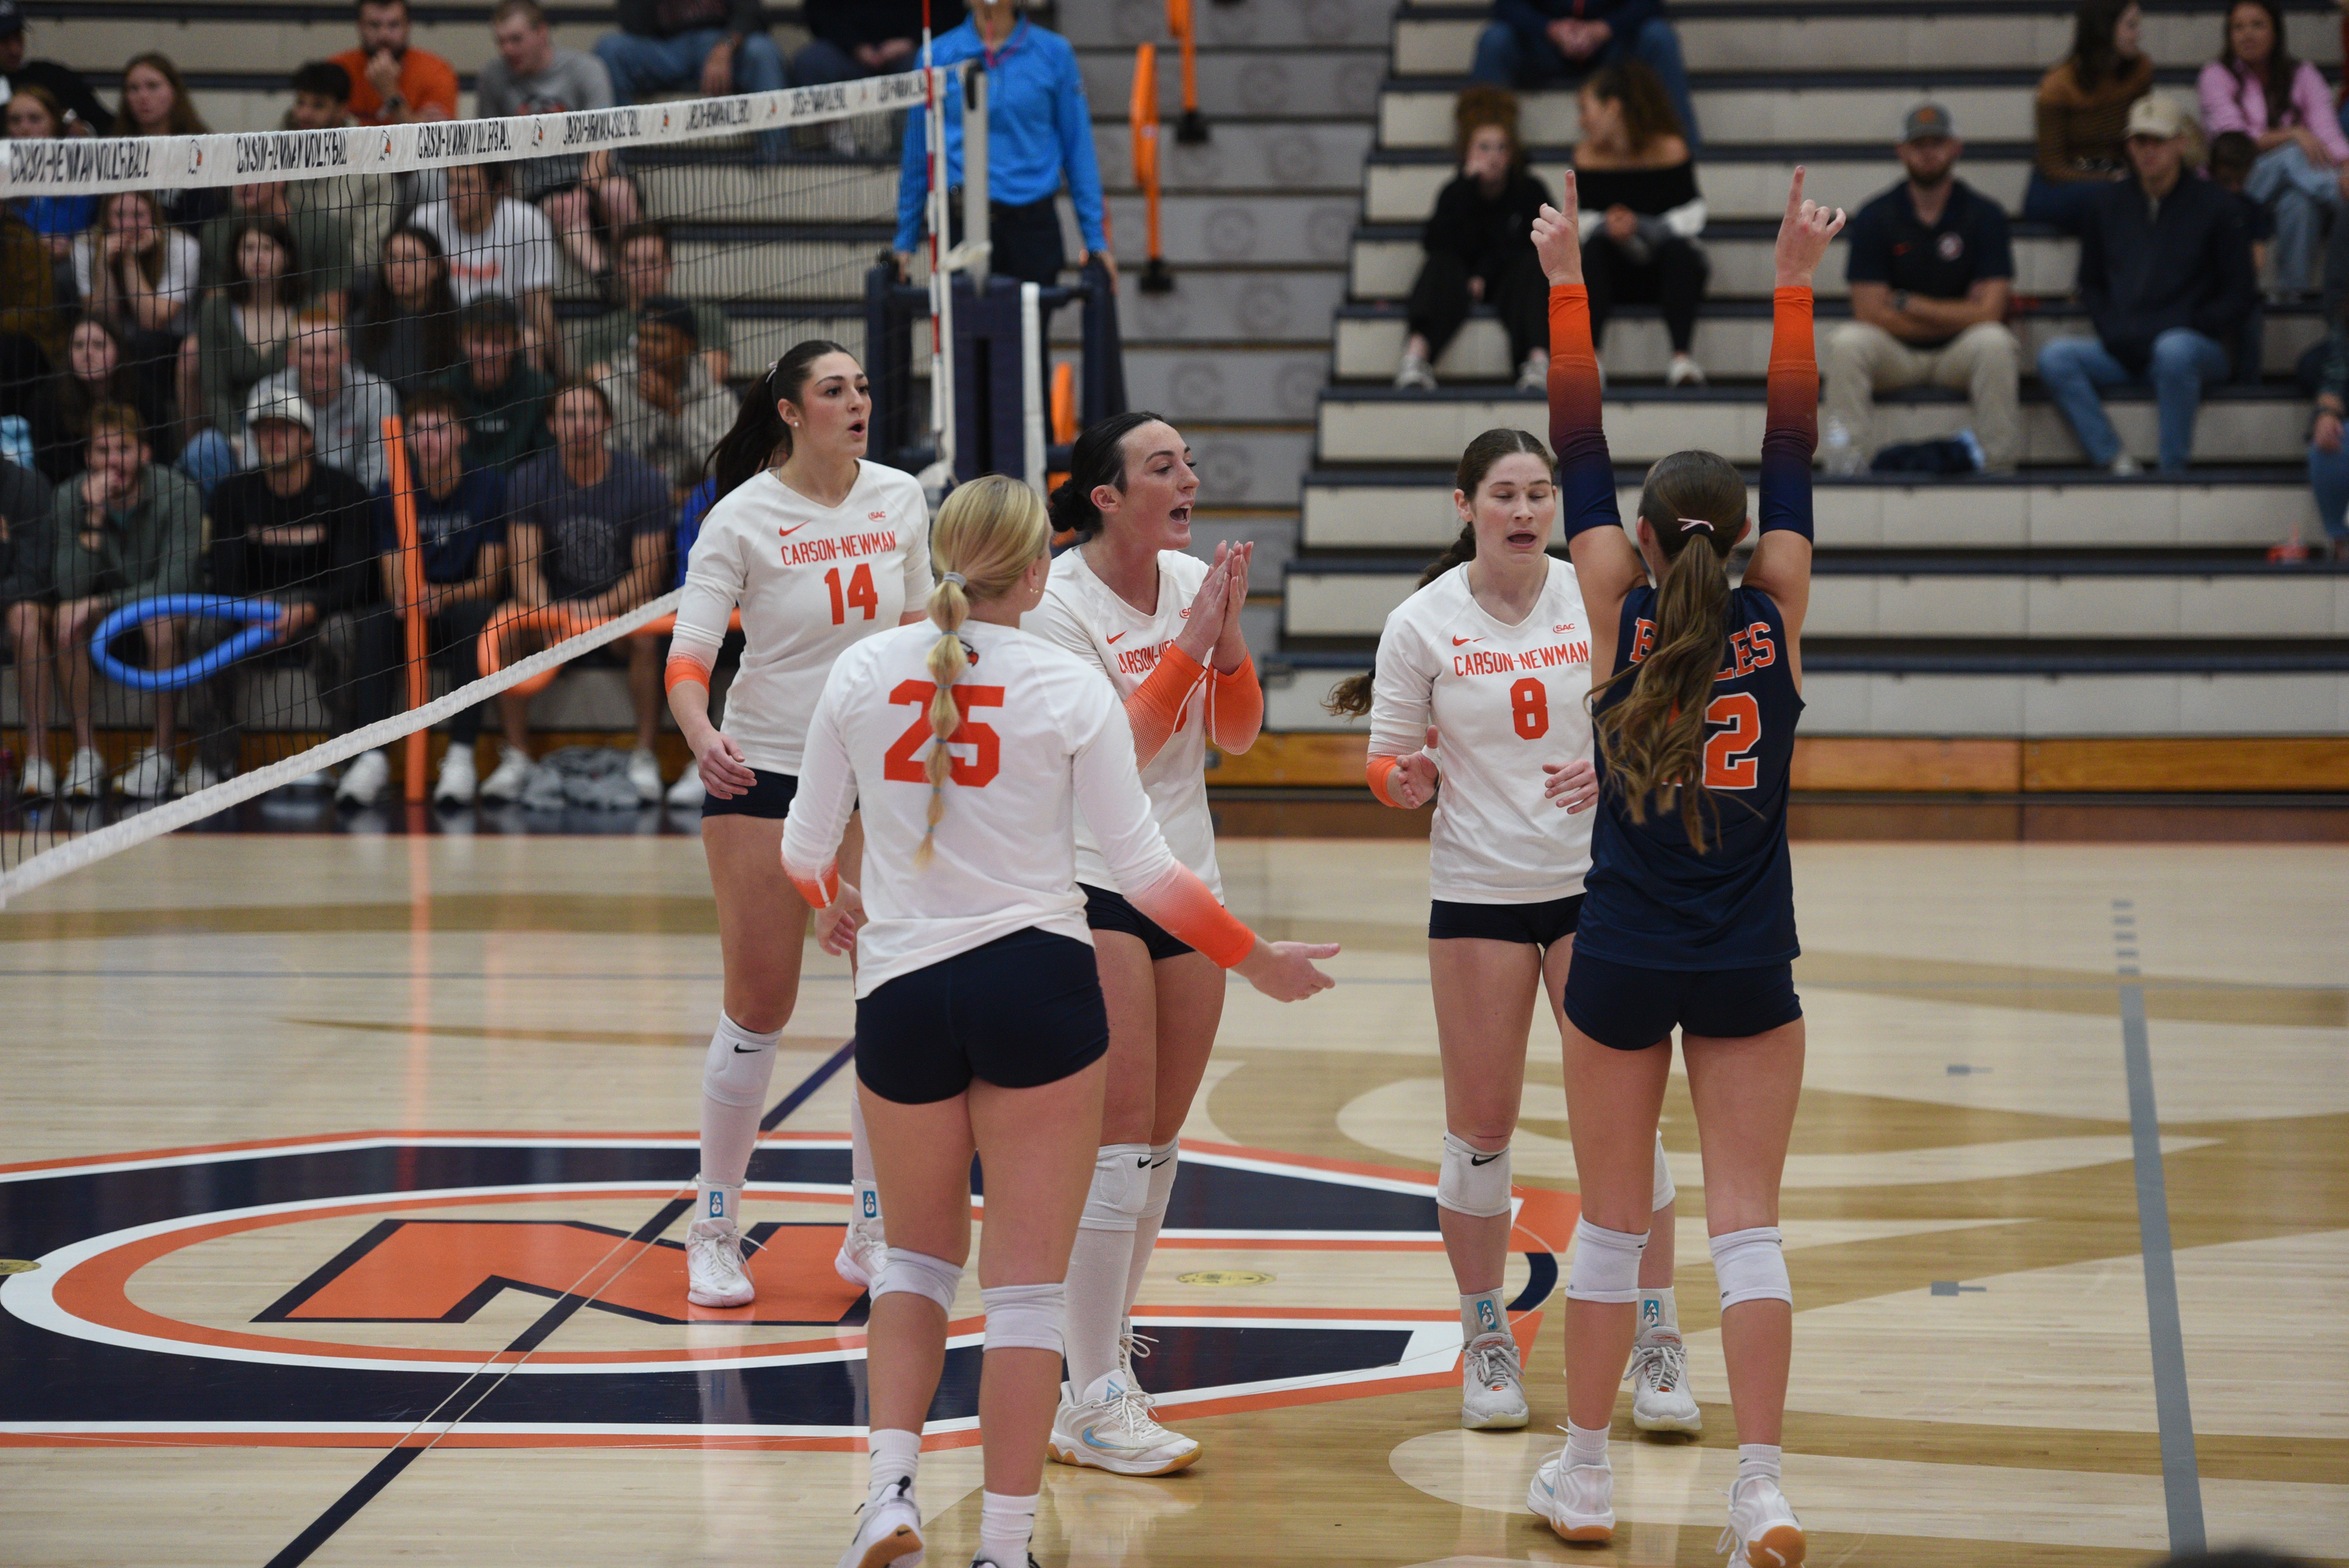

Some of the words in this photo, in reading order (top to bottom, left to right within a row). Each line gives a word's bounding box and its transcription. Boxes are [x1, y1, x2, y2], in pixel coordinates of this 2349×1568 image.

[781, 530, 896, 565] CARSON-NEWMAN
[824, 563, 878, 625] 14
[1555, 623, 1575, 632] SAC
[1454, 641, 1589, 676] CARSON-NEWMAN
[1510, 677, 1549, 740] 8
[884, 679, 1005, 788] 25
